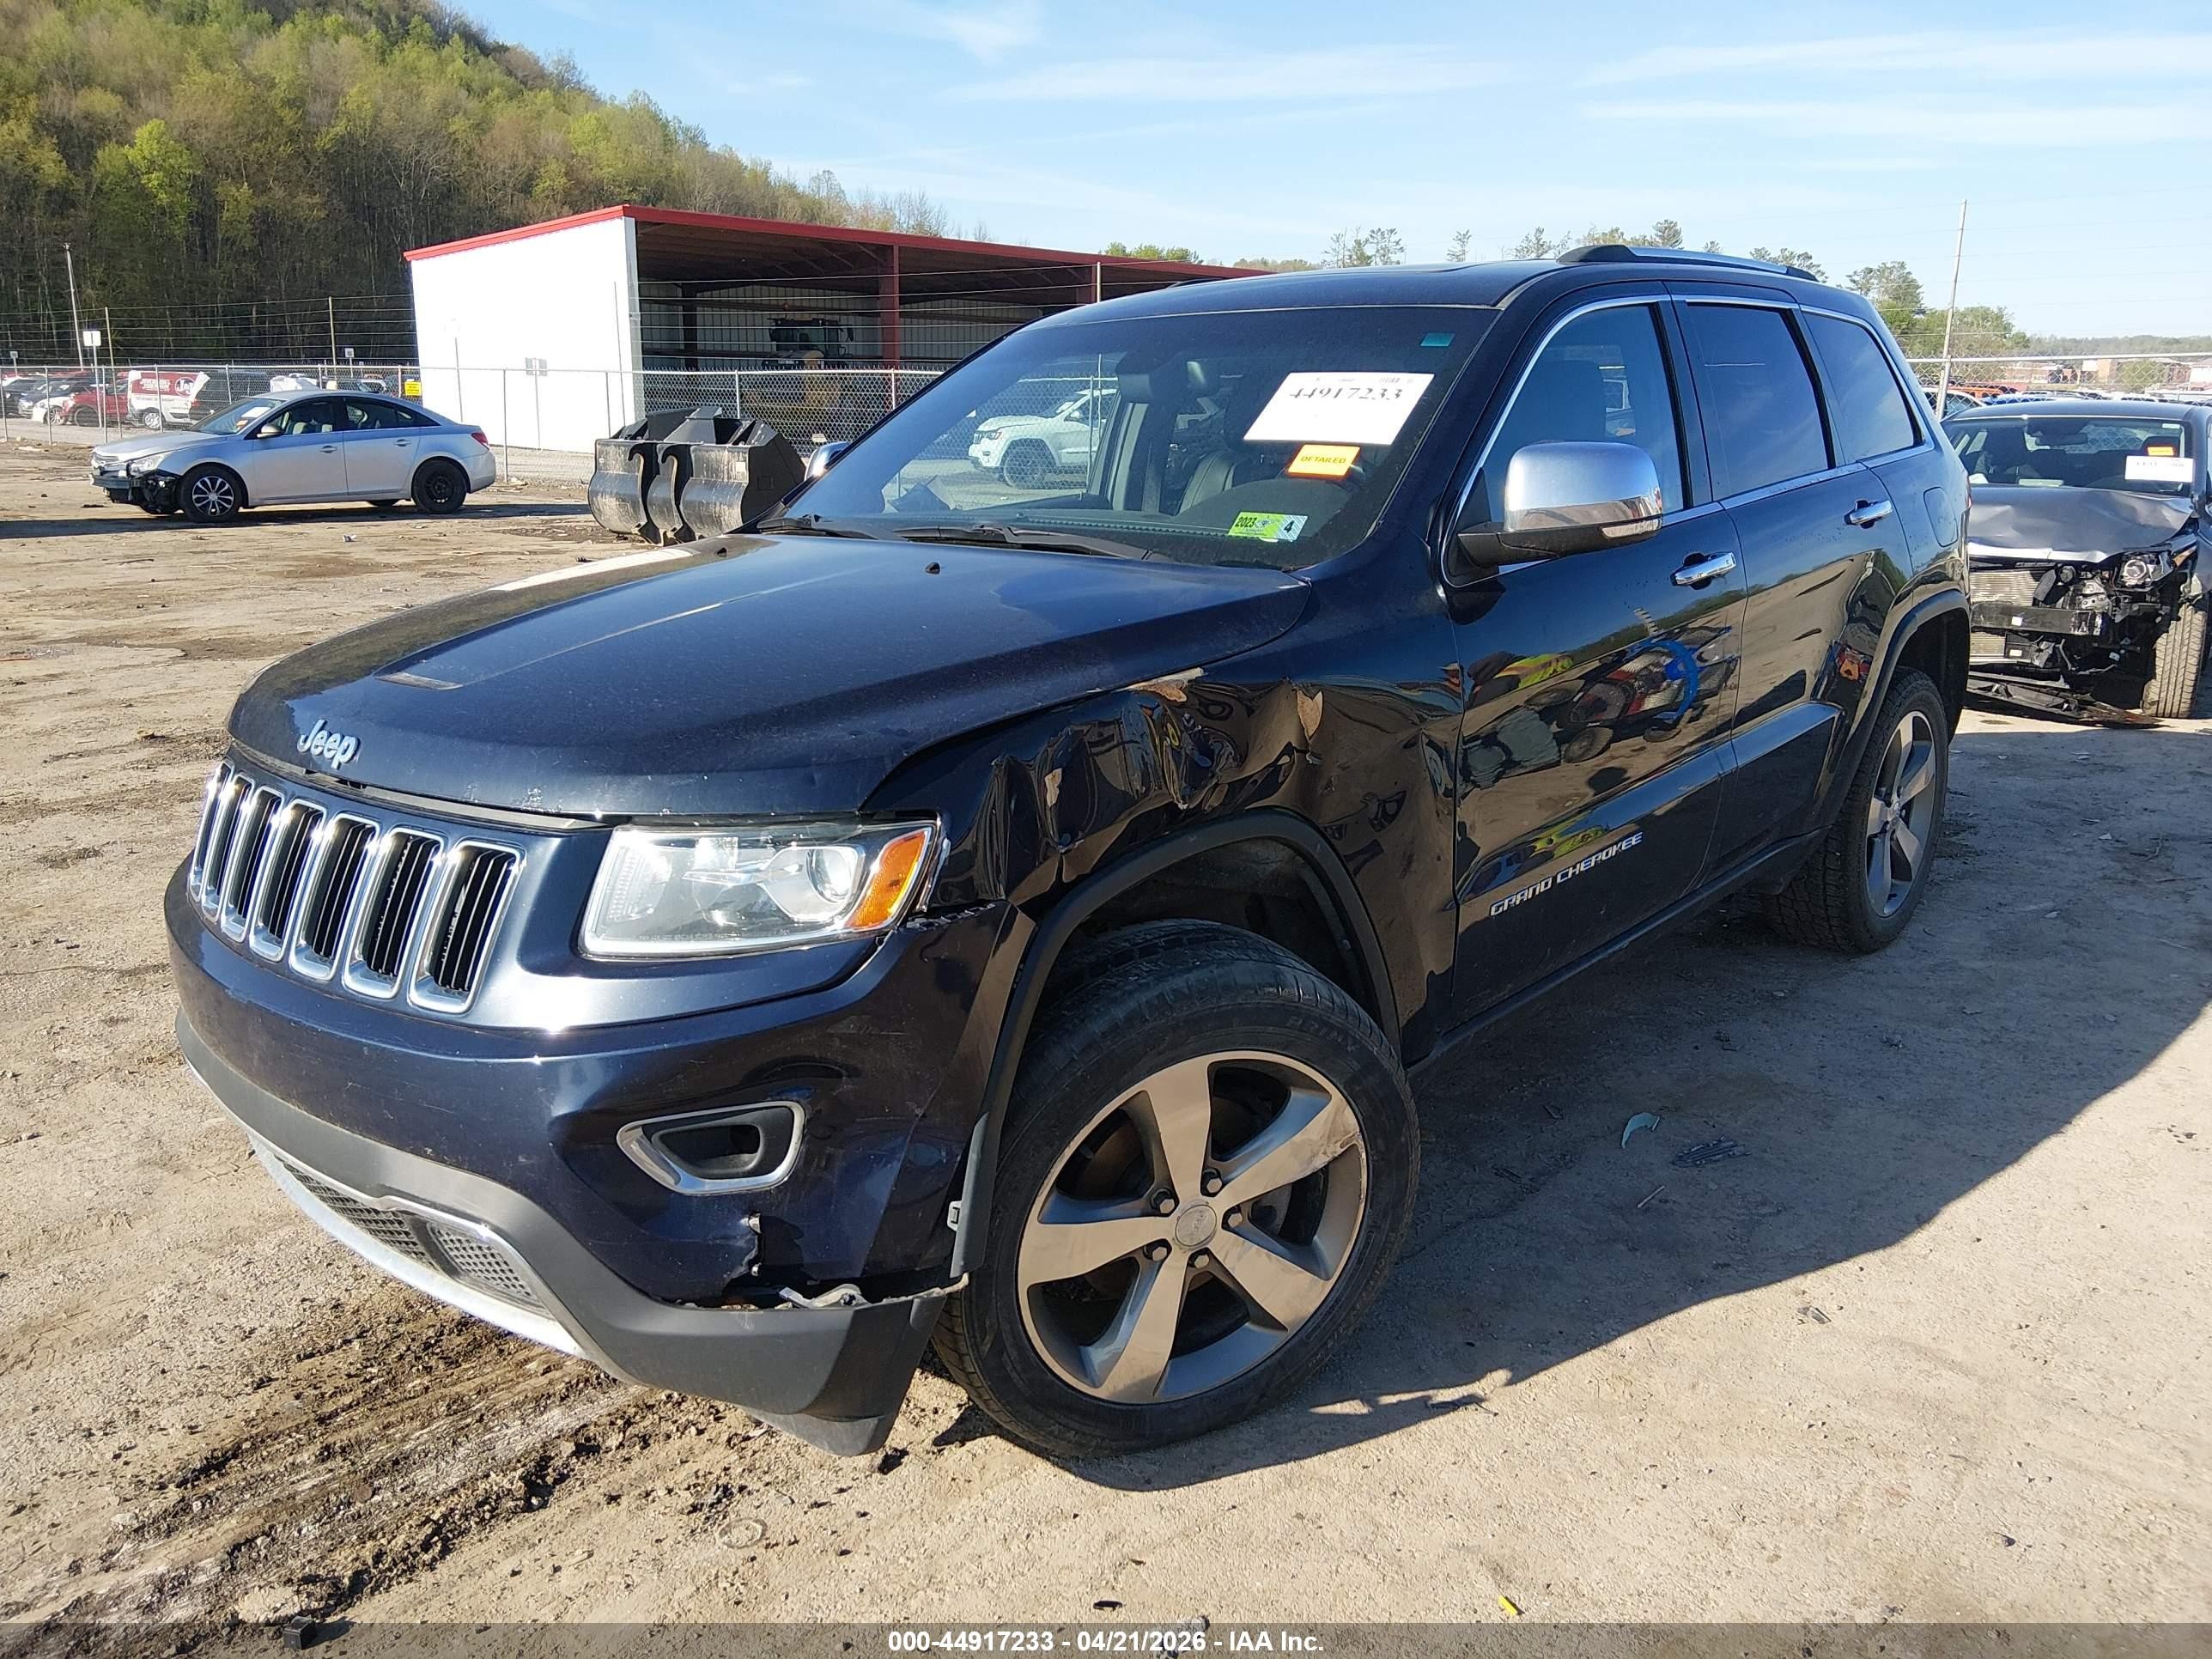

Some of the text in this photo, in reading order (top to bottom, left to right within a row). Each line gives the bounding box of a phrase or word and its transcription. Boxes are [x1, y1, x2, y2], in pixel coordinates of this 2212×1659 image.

[1289, 387, 1403, 400] 44917233
[1235, 516, 1258, 528] 2023
[1283, 520, 1295, 533] 4
[297, 719, 357, 770] Jeep
[1490, 831, 1644, 917] GRAND CHEROKEE
